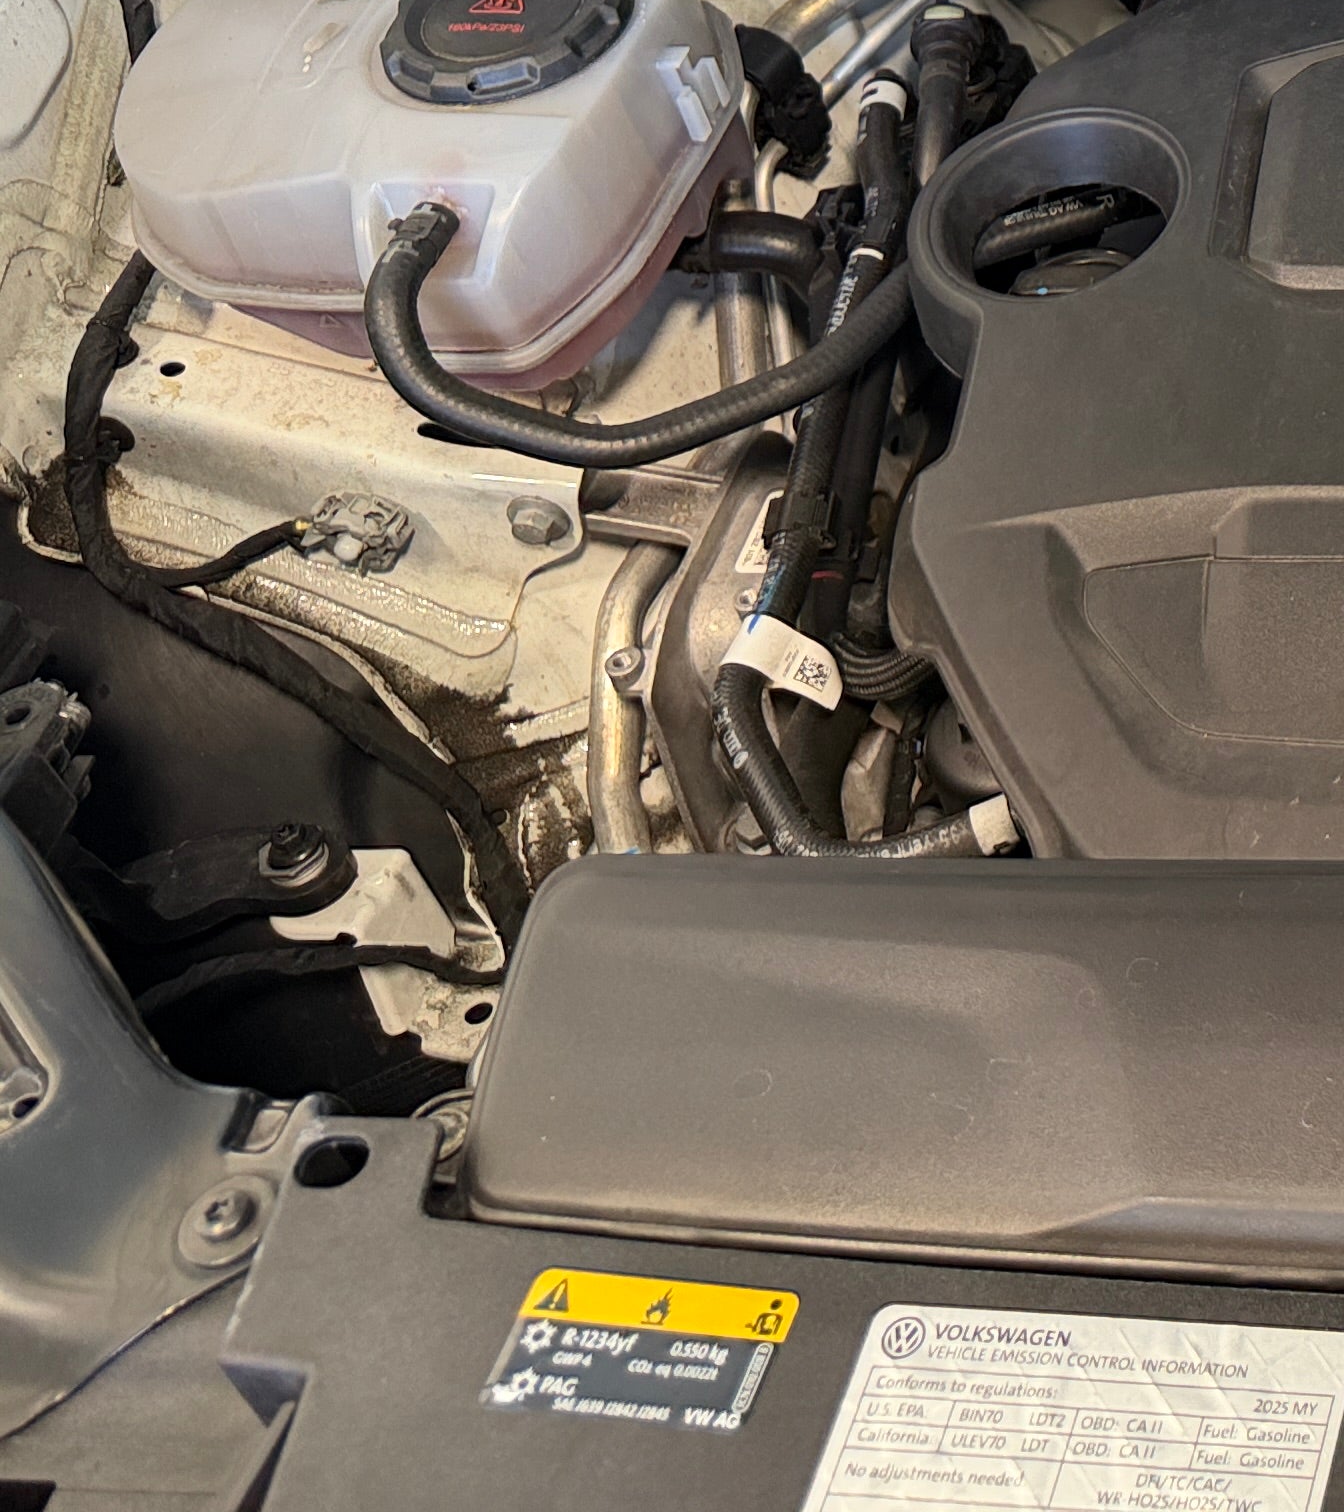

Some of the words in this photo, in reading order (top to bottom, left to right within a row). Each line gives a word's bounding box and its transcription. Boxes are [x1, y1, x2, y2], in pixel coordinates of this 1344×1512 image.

[561, 1326, 639, 1356] R-1234yf
[708, 1342, 729, 1366] kg
[935, 1322, 1073, 1348] VOLKSWAGEN
[926, 1344, 986, 1363] VEHICLE
[990, 1347, 1065, 1367] EMISSION
[1067, 1351, 1137, 1372] CONTROL
[1140, 1358, 1250, 1379] INFORMATION
[539, 1375, 579, 1397] PAG
[875, 1374, 947, 1390] Conforms
[951, 1378, 967, 1394] to
[684, 1406, 716, 1426] VW
[712, 1409, 742, 1430] AG
[958, 1407, 1005, 1425] BIN70
[1028, 1410, 1068, 1429] LDT2
[1253, 1398, 1290, 1416] 2025
[1292, 1400, 1319, 1418] MY
[1080, 1415, 1119, 1432] OBD:
[1126, 1417, 1148, 1435] CA
[1203, 1423, 1238, 1441] Fuel:
[1246, 1427, 1312, 1445] Gasoline
[950, 1434, 1007, 1451] ULEV70
[1020, 1437, 1051, 1453] LDT
[1118, 1443, 1140, 1459] CA
[1195, 1449, 1231, 1467] Fuel:
[1238, 1452, 1306, 1470] Gasoline
[844, 1462, 867, 1478] No
[868, 1463, 965, 1486] adjustments
